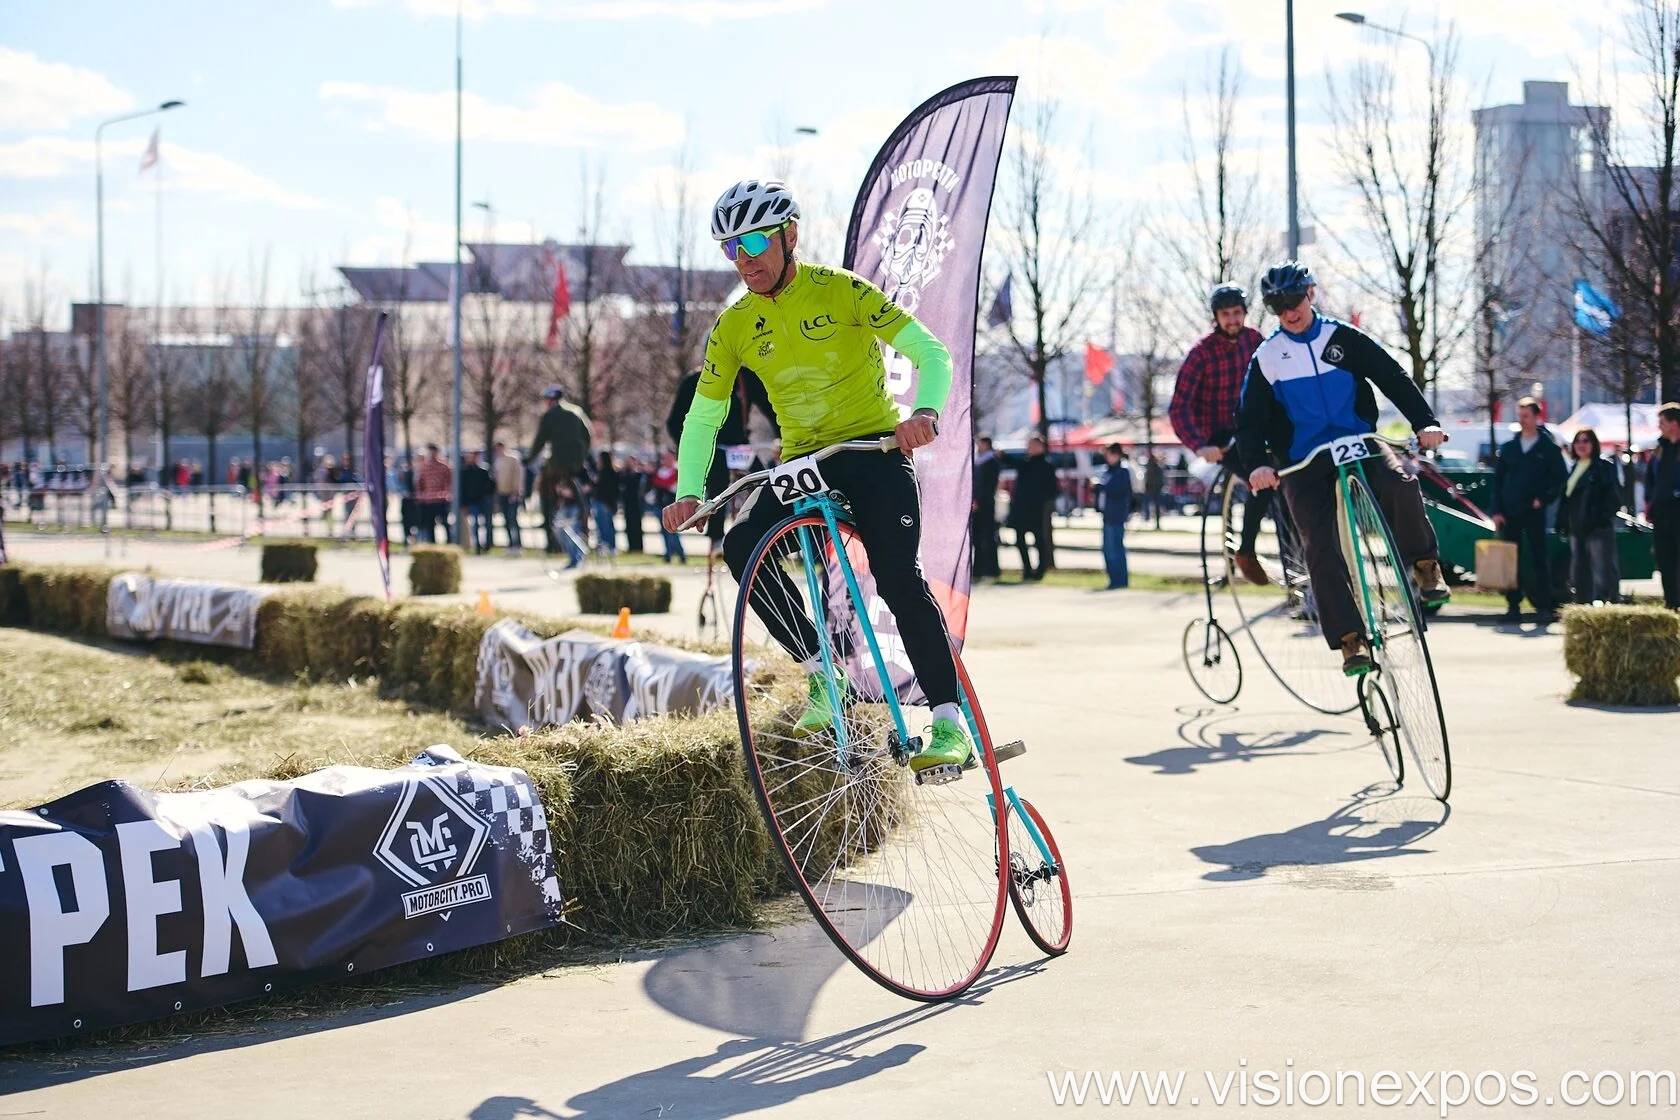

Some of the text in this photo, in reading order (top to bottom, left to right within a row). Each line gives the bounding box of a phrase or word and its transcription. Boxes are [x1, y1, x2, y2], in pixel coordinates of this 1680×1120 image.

[803, 314, 838, 331] LCL
[1335, 442, 1367, 463] 23
[774, 467, 823, 503] 20
[0, 817, 279, 1007] РЕК
[408, 880, 485, 914] MOTORCITY.PRO
